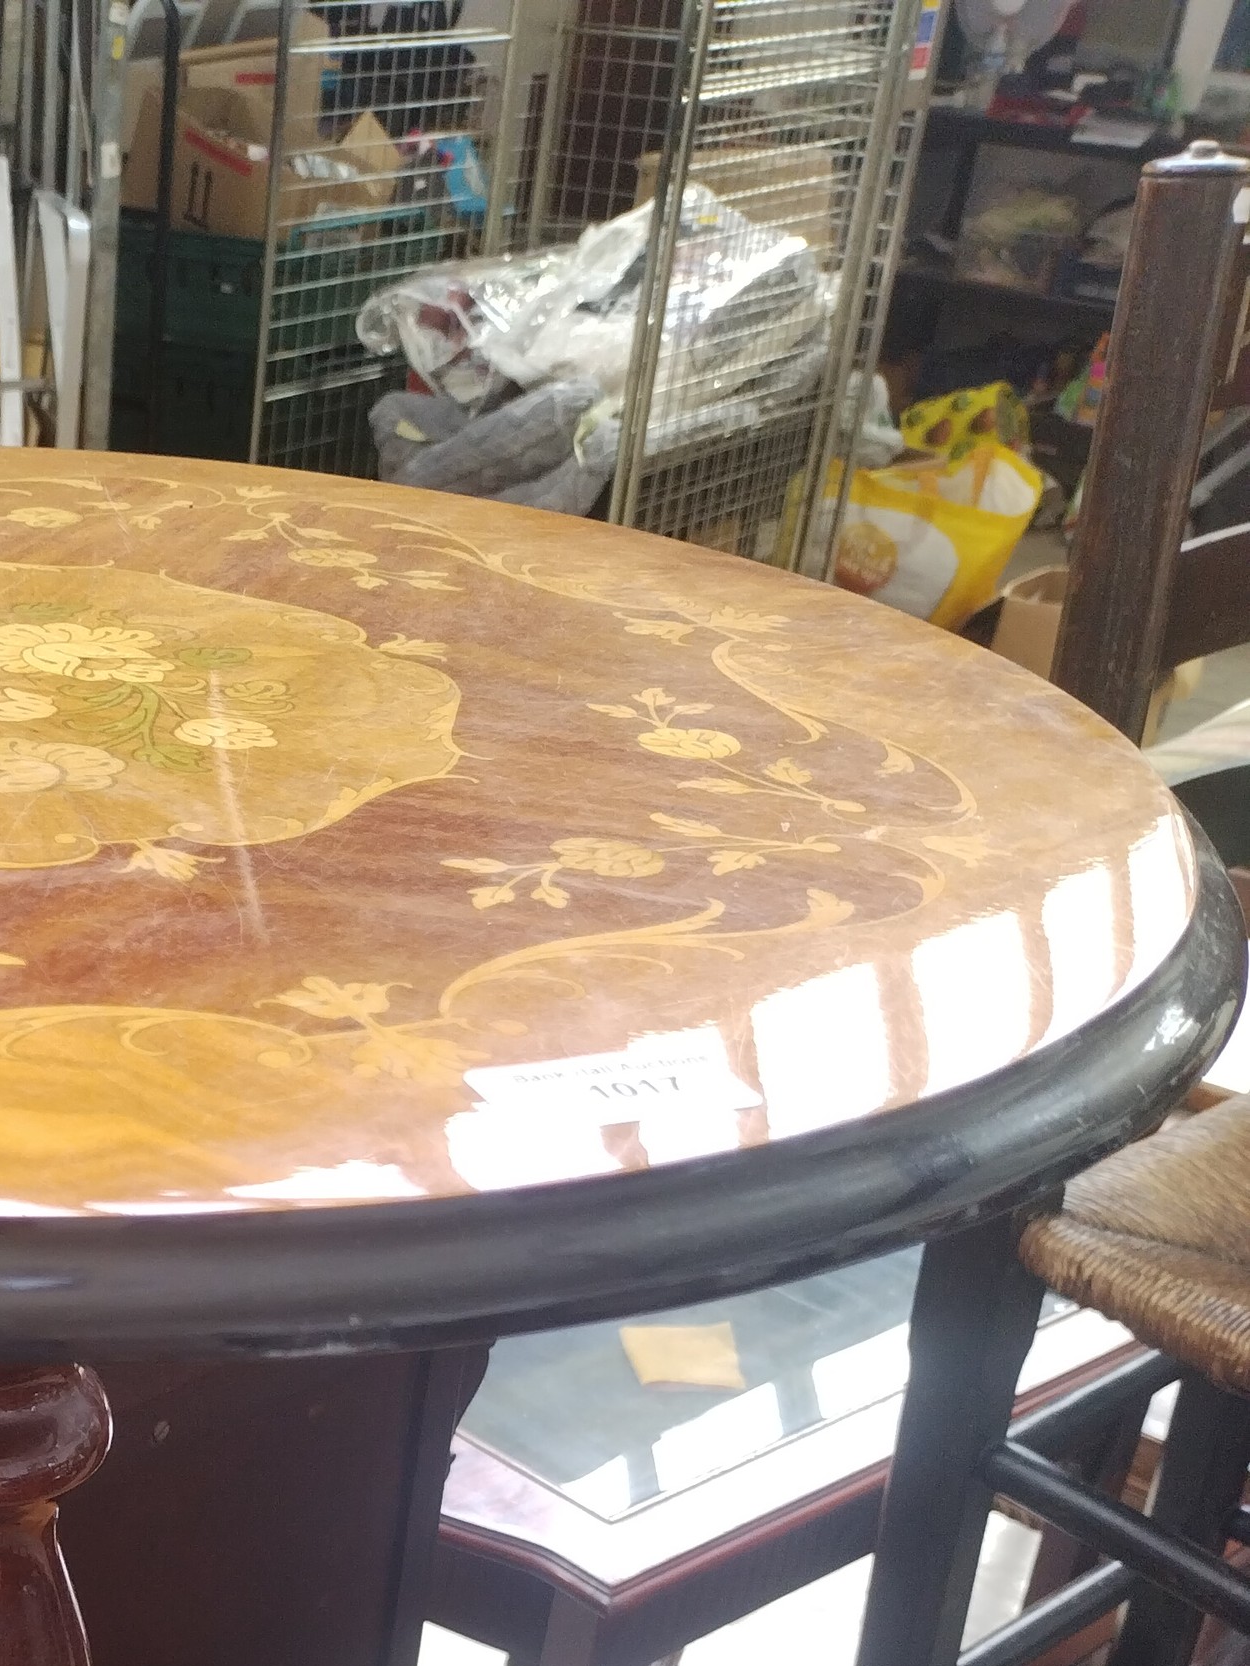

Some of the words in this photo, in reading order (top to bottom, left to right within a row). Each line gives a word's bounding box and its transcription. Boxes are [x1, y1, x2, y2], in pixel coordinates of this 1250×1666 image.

[513, 1072, 565, 1085] Bank
[621, 1055, 708, 1071] Auctions
[588, 1075, 680, 1099] 1017
